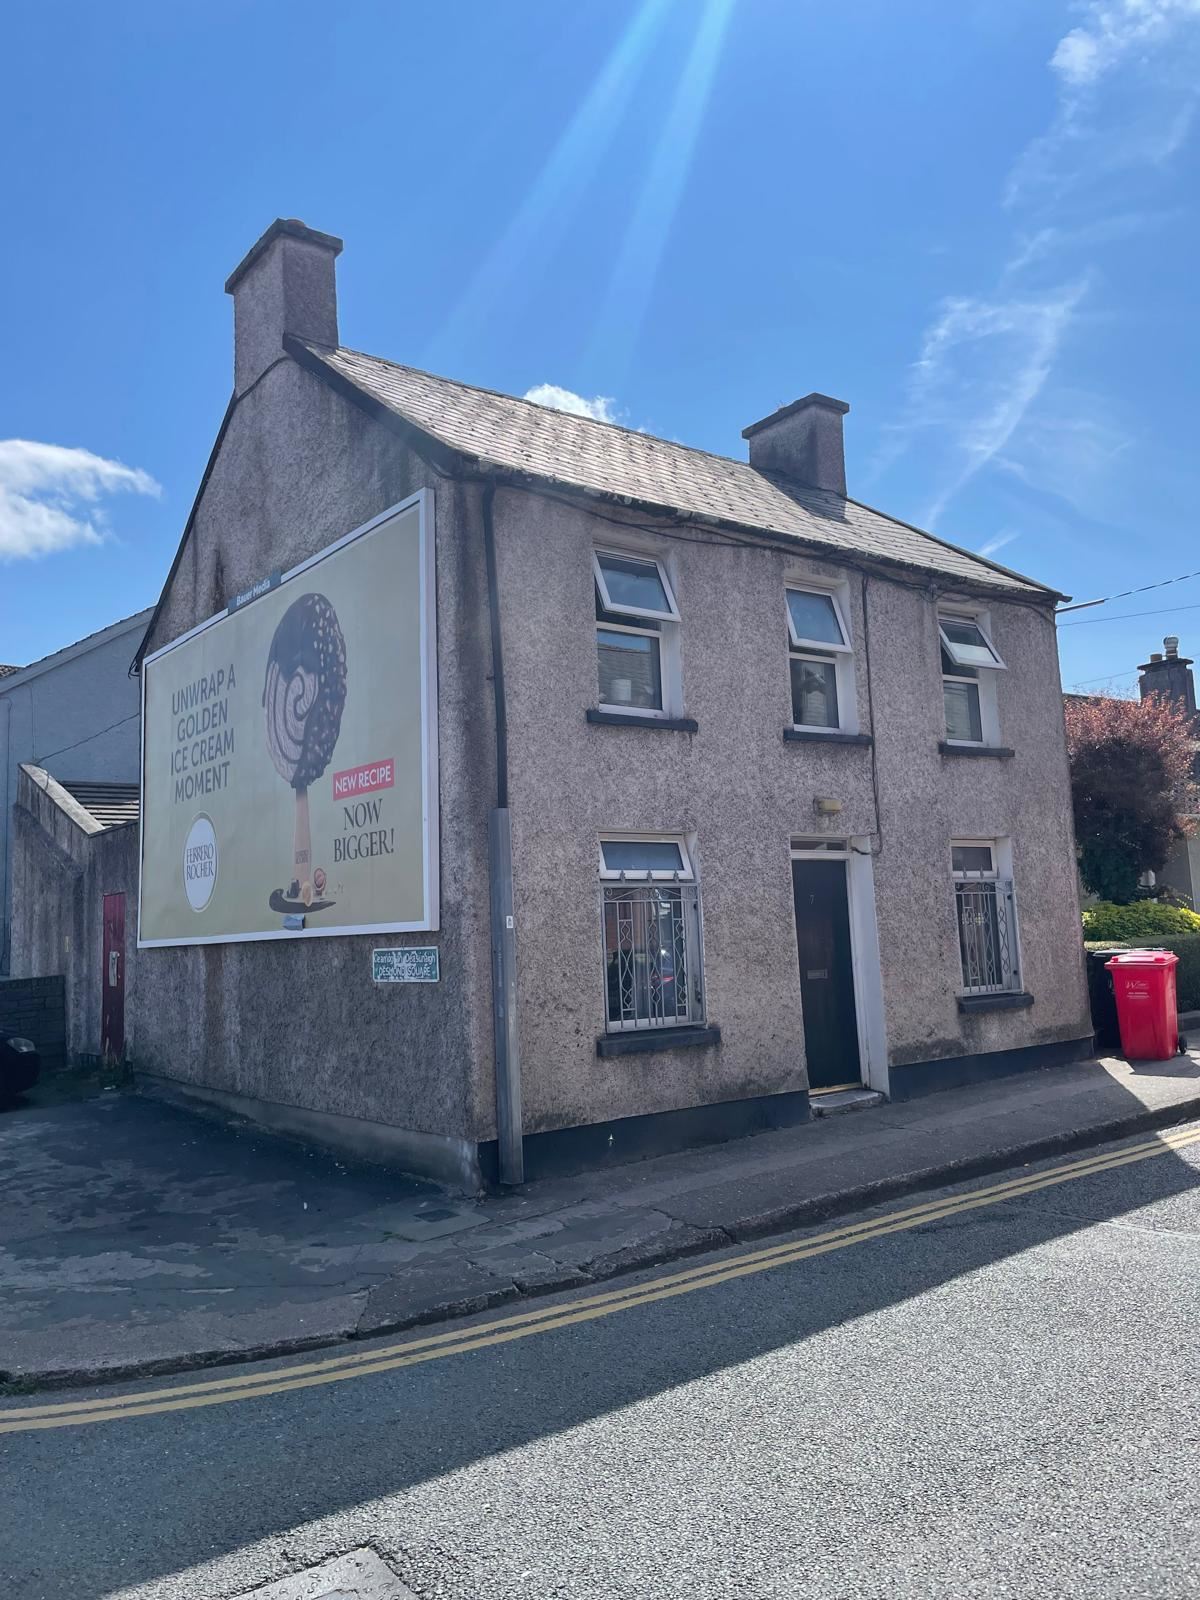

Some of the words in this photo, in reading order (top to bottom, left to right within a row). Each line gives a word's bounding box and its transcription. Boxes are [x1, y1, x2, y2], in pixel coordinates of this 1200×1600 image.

[236, 590, 253, 606] Bauer
[252, 578, 271, 597] Media
[172, 668, 225, 716] UNWRAP
[227, 663, 236, 689] A
[177, 698, 228, 743] GOLDEN
[170, 749, 188, 777] ICE
[191, 728, 235, 768] CREAM
[175, 761, 230, 804] MOMENT
[335, 773, 358, 794] NEW
[358, 765, 391, 788] RECIPE
[343, 798, 383, 831] NOW
[186, 843, 214, 865] FERRERO
[334, 828, 394, 862] BIGGER!
[186, 860, 214, 881] ROCHER
[809, 894, 815, 905] 7
[379, 966, 405, 976] DESMOND
[407, 966, 431, 977] SQUARE
